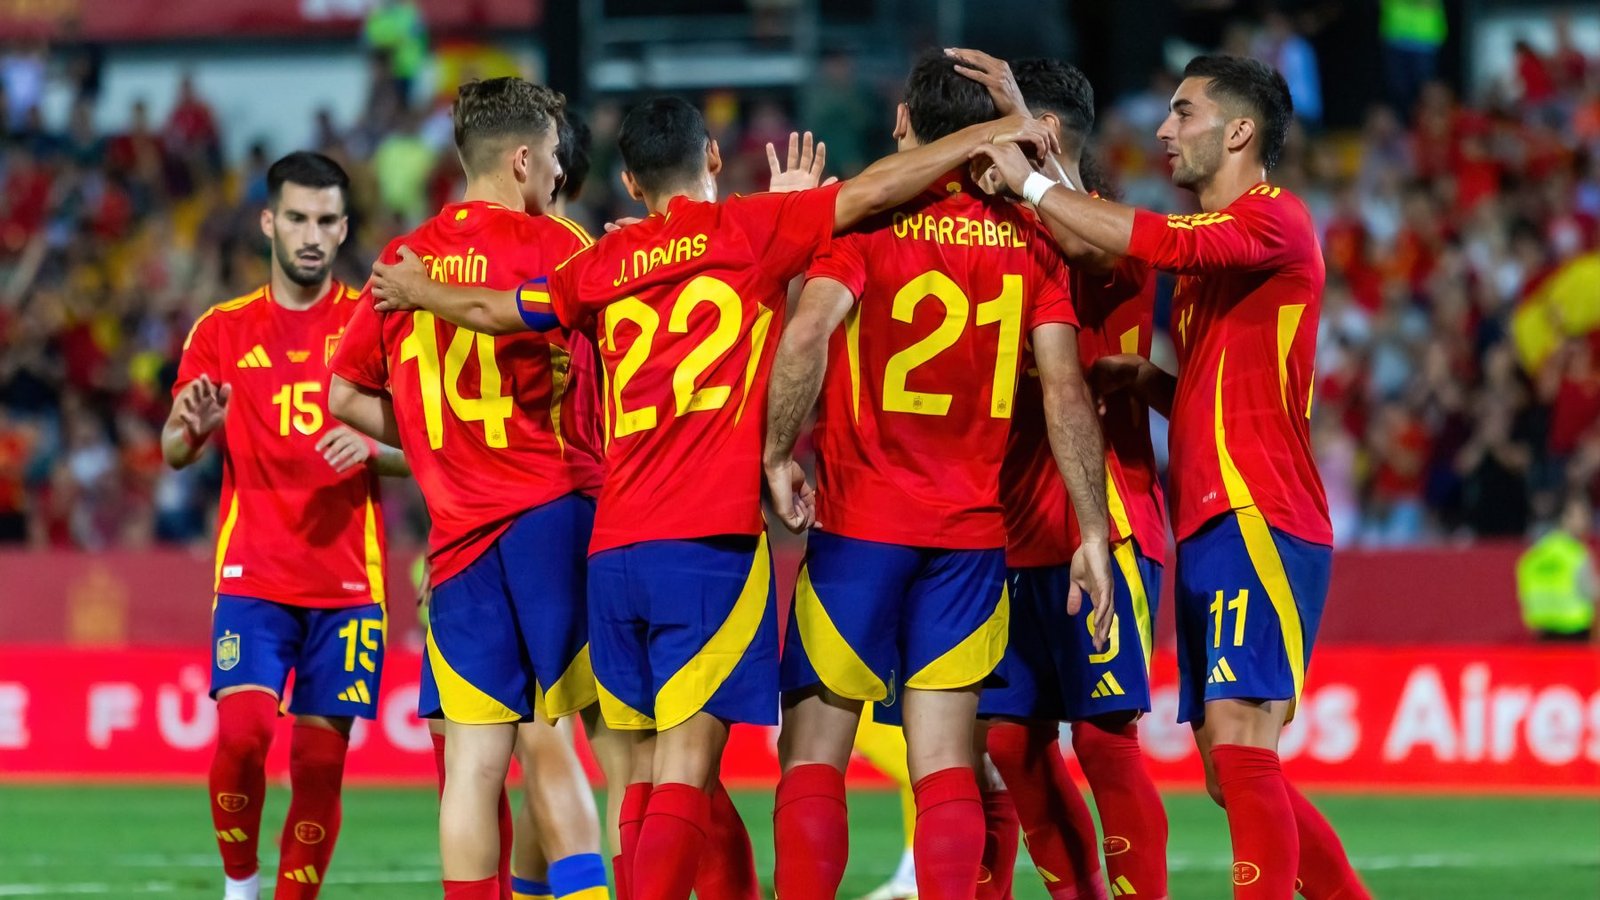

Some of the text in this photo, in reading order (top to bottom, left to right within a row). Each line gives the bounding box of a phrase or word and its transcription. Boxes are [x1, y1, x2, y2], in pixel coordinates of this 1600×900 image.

[893, 212, 1026, 248] OYARZABAL
[613, 233, 708, 287] J. NAVAS
[604, 275, 743, 438] 22
[882, 269, 1023, 418] 21
[400, 310, 513, 450] 14
[272, 382, 323, 436] 15
[1086, 610, 1120, 664] 9
[1210, 589, 1249, 648] 11
[338, 619, 382, 673] 15
